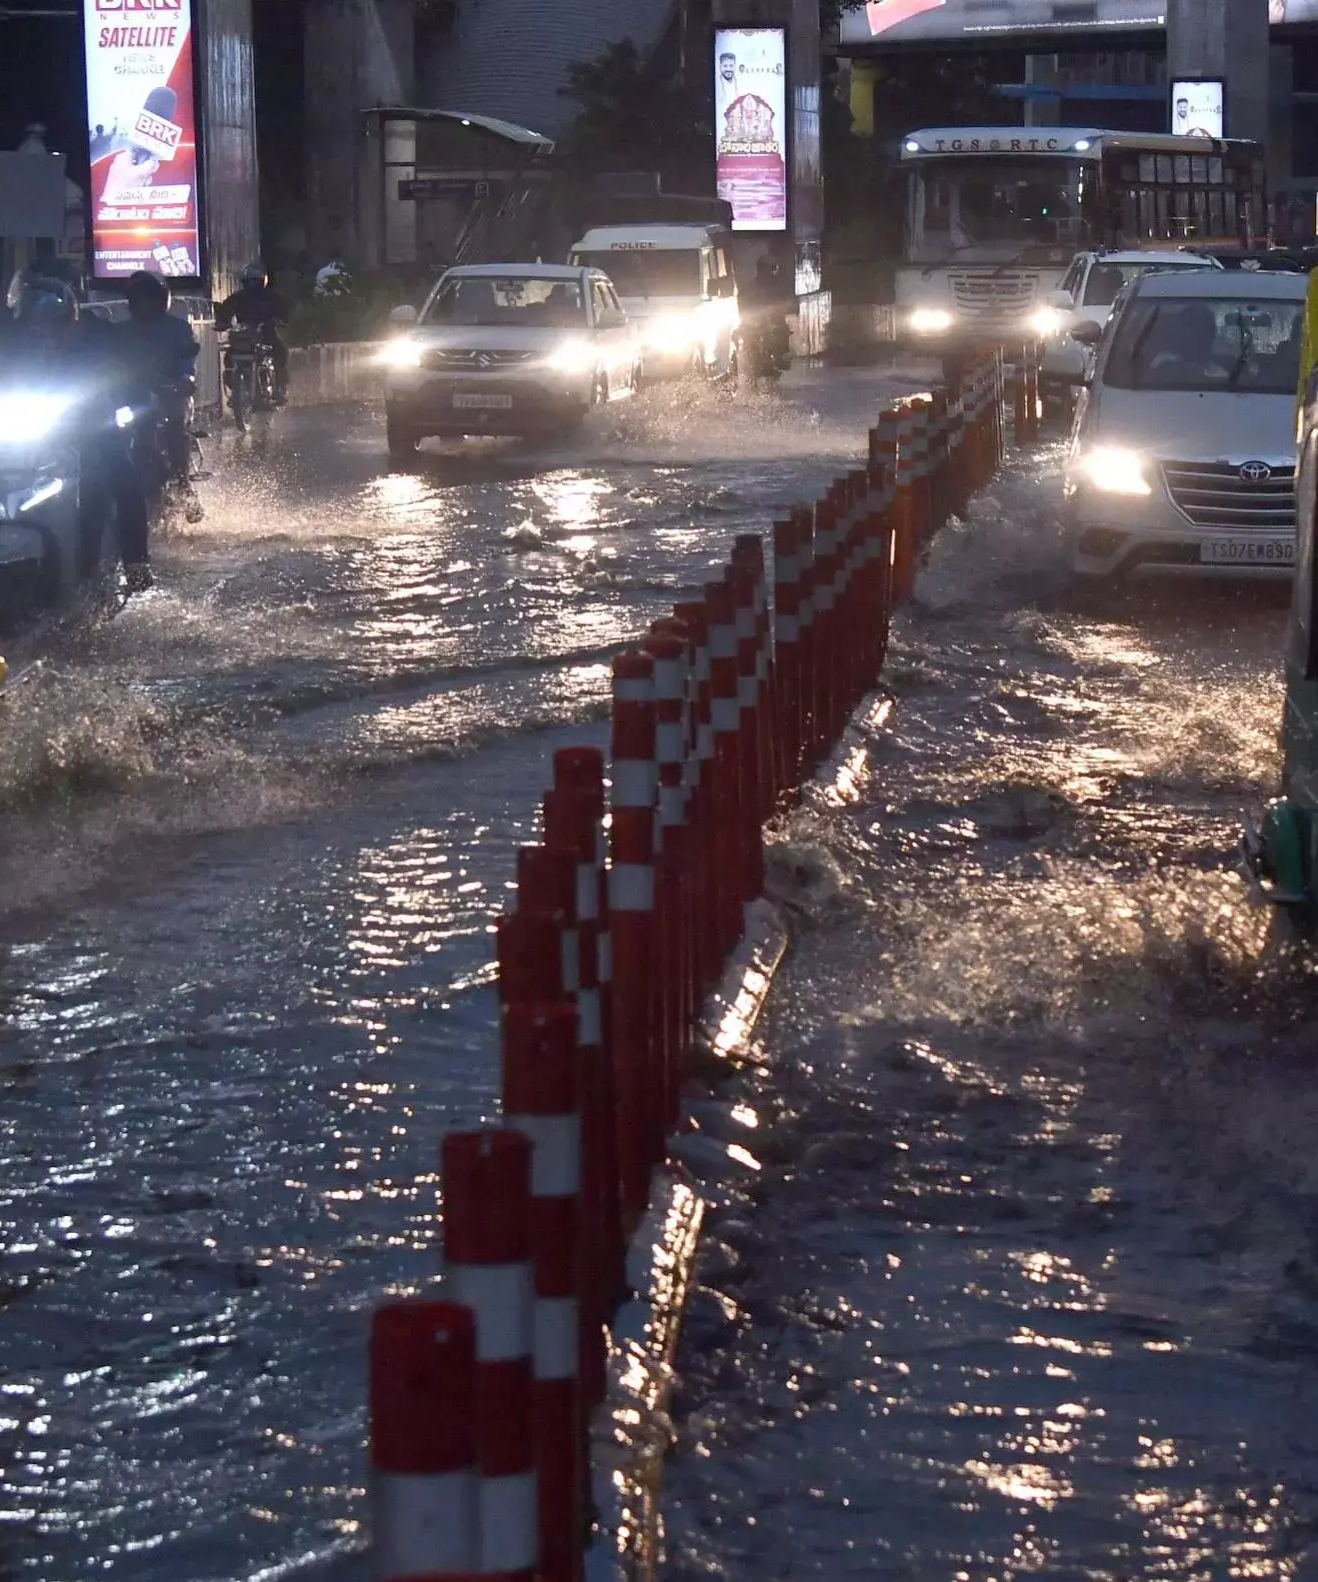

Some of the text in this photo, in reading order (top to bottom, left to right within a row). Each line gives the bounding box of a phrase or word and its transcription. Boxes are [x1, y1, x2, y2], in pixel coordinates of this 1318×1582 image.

[98, 26, 177, 48] SATELLITE
[135, 112, 179, 146] BRK
[610, 241, 658, 249] POLICE
